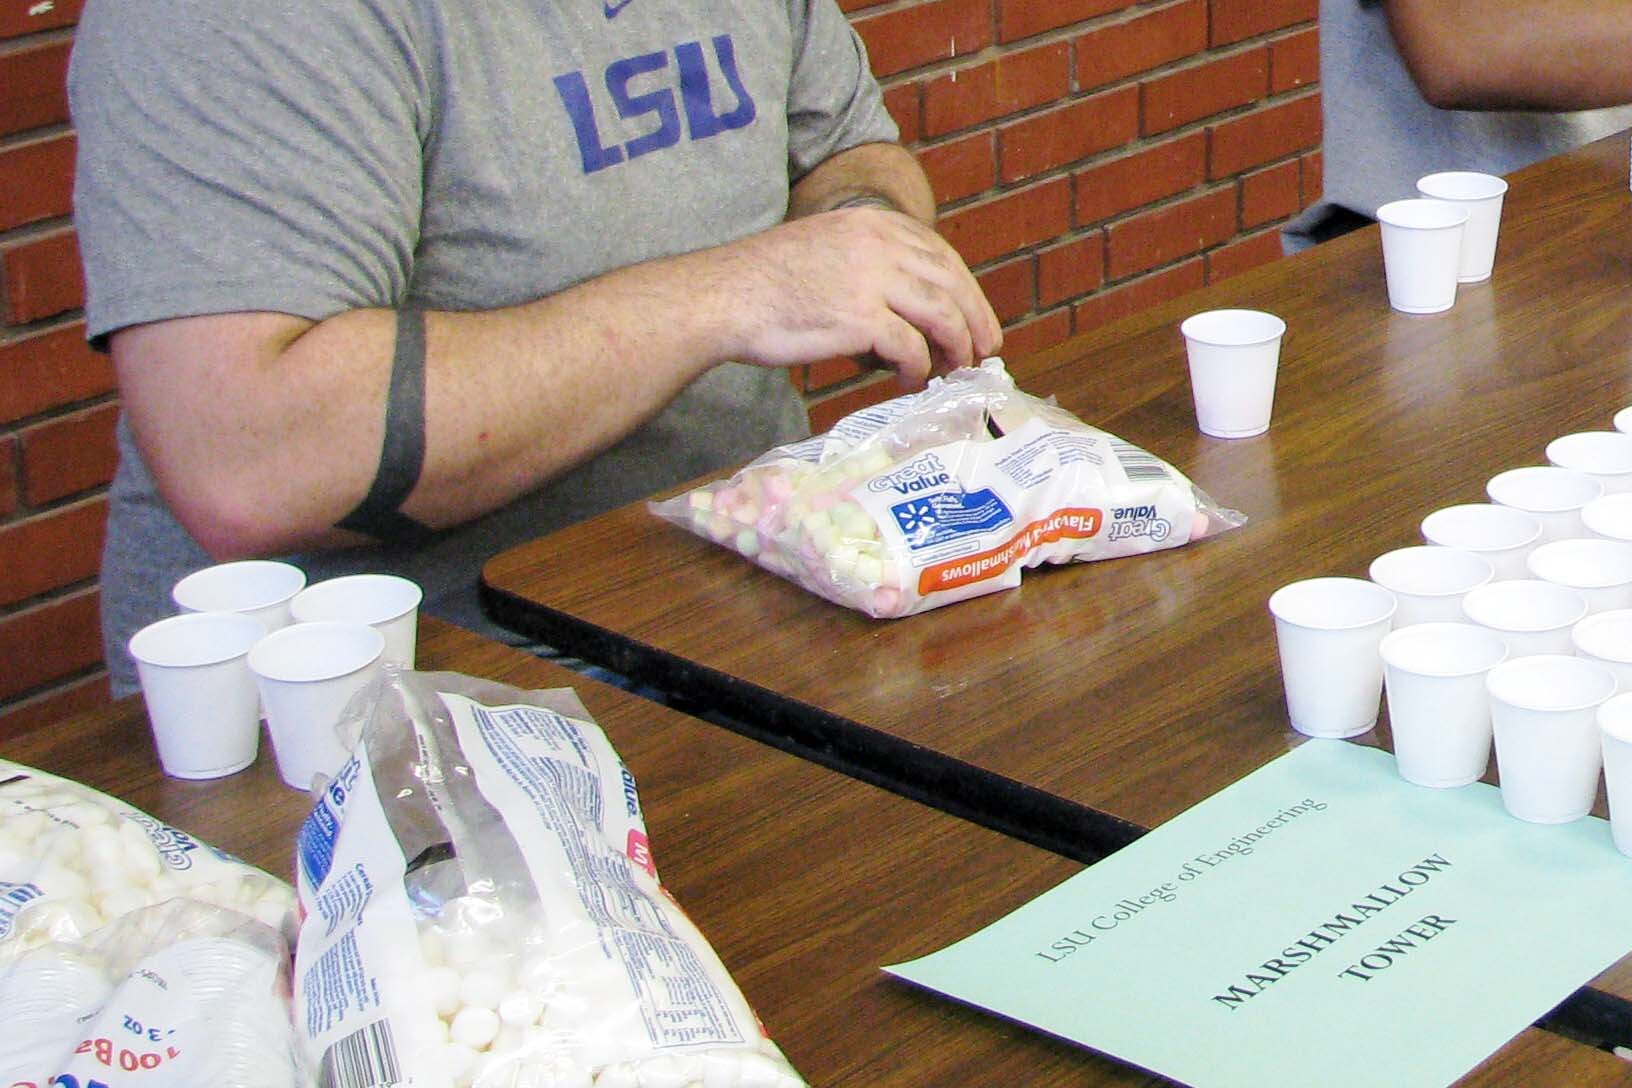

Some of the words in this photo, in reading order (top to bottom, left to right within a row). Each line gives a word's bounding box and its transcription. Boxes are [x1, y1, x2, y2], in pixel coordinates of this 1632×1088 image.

[553, 33, 756, 175] LSU
[868, 453, 945, 493] Great
[893, 472, 950, 494] Value
[1109, 518, 1172, 542] Great
[1114, 505, 1157, 520] Value
[619, 761, 638, 817] alue
[1035, 929, 1096, 963] LSU
[1091, 879, 1179, 933] College
[1178, 861, 1204, 883] of
[1193, 795, 1328, 869] Engineering
[1211, 852, 1454, 1011] MARSHMALLOW
[1336, 912, 1457, 985] TOWER
